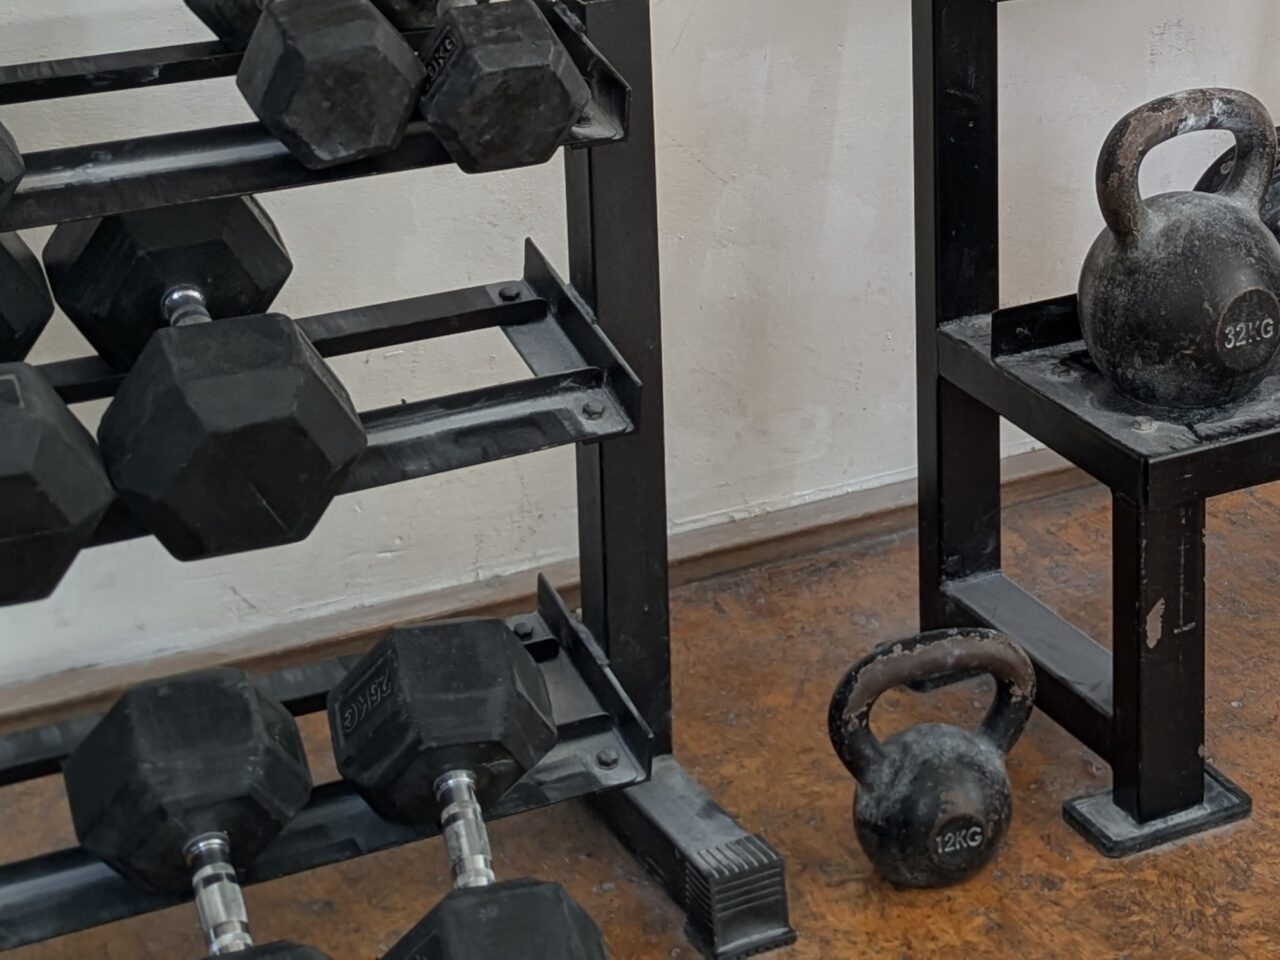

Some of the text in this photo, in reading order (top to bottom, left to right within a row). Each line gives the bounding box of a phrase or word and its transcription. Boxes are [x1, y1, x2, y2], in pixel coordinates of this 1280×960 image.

[1224, 317, 1275, 349] 32KG
[342, 667, 393, 733] 25KG
[935, 826, 983, 854] 12KG
